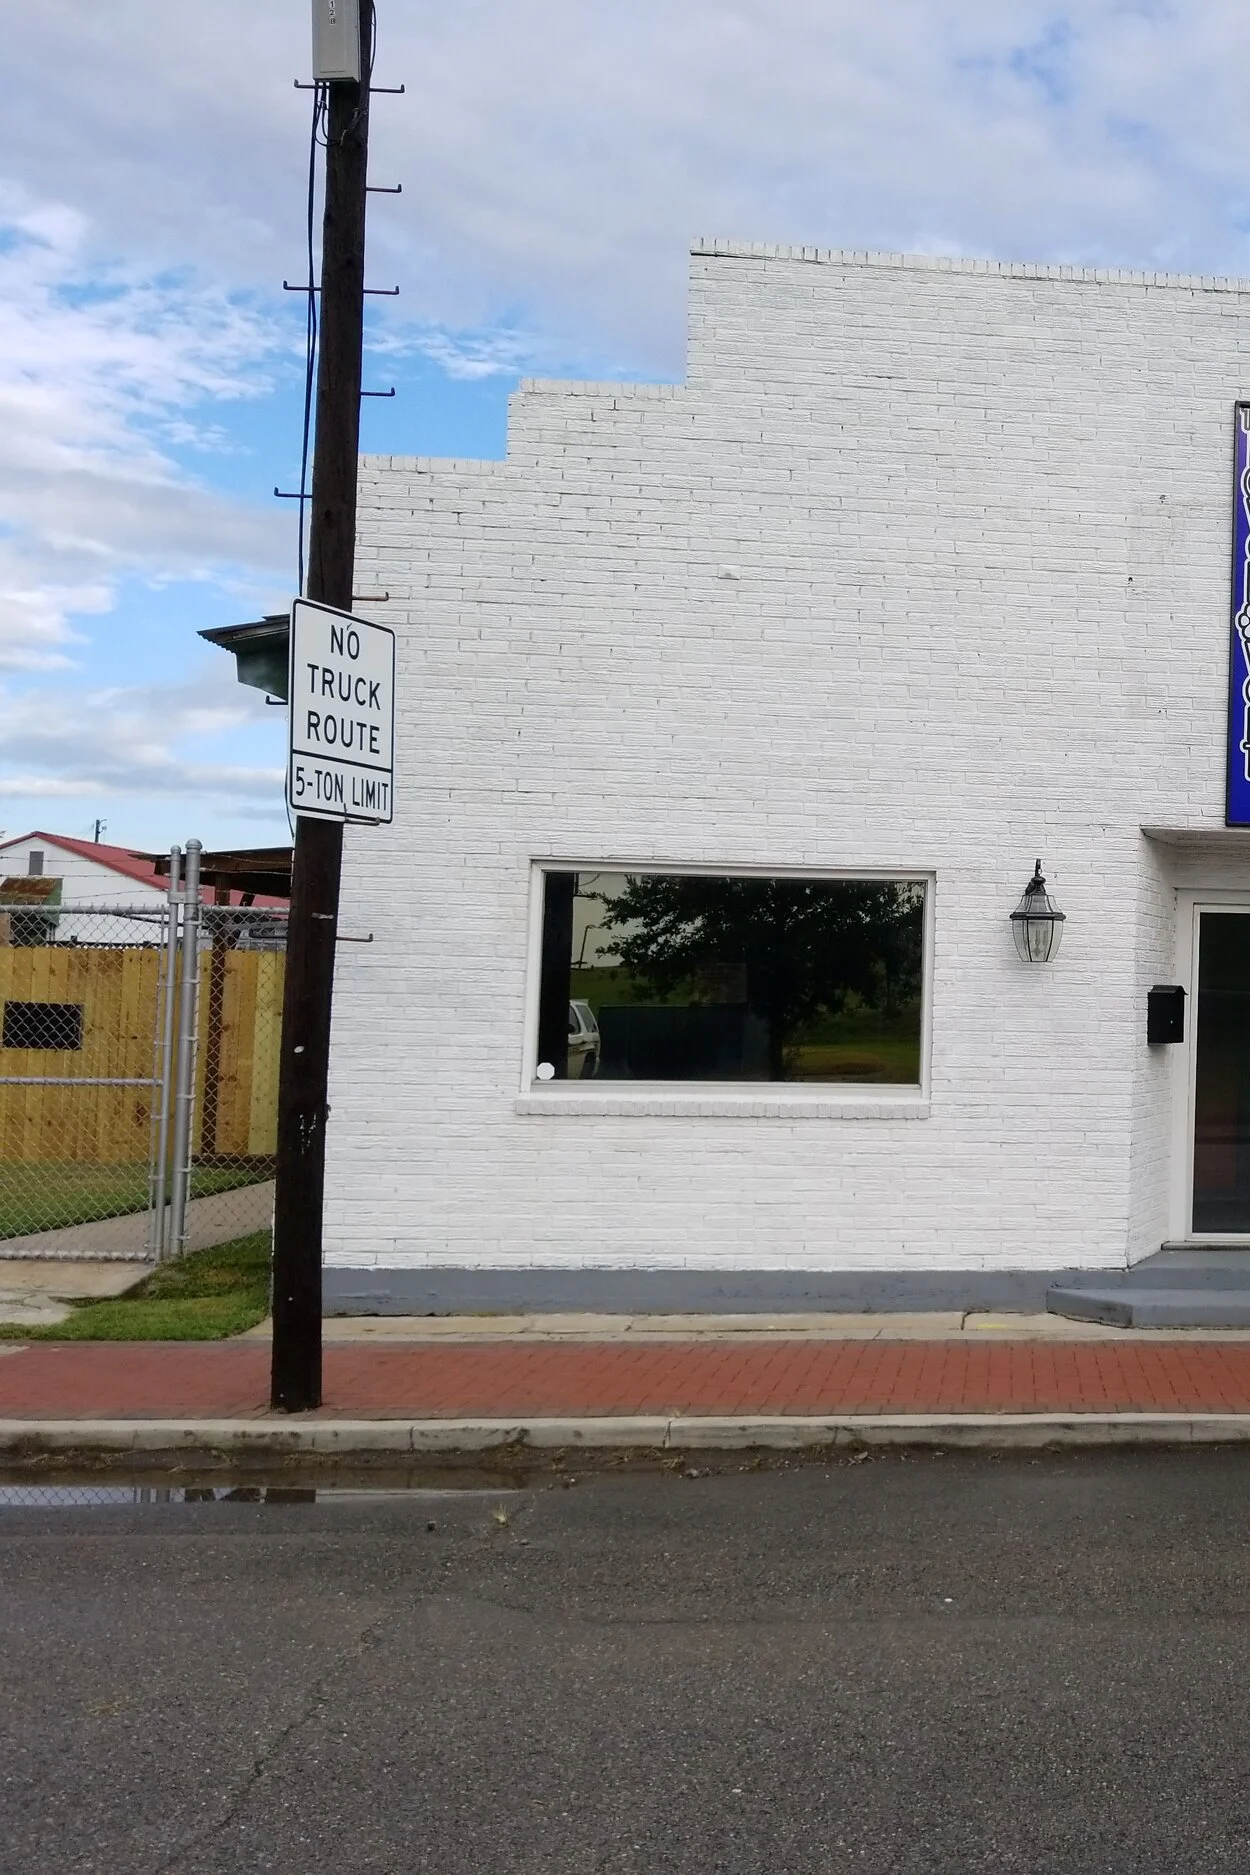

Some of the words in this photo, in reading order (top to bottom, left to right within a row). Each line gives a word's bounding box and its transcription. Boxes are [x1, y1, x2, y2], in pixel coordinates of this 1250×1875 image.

[330, 624, 360, 660] NO
[307, 663, 381, 711] TRUCK
[307, 710, 381, 755] ROUTE
[295, 766, 344, 803] 5-TON
[352, 776, 389, 811] LIMIT
